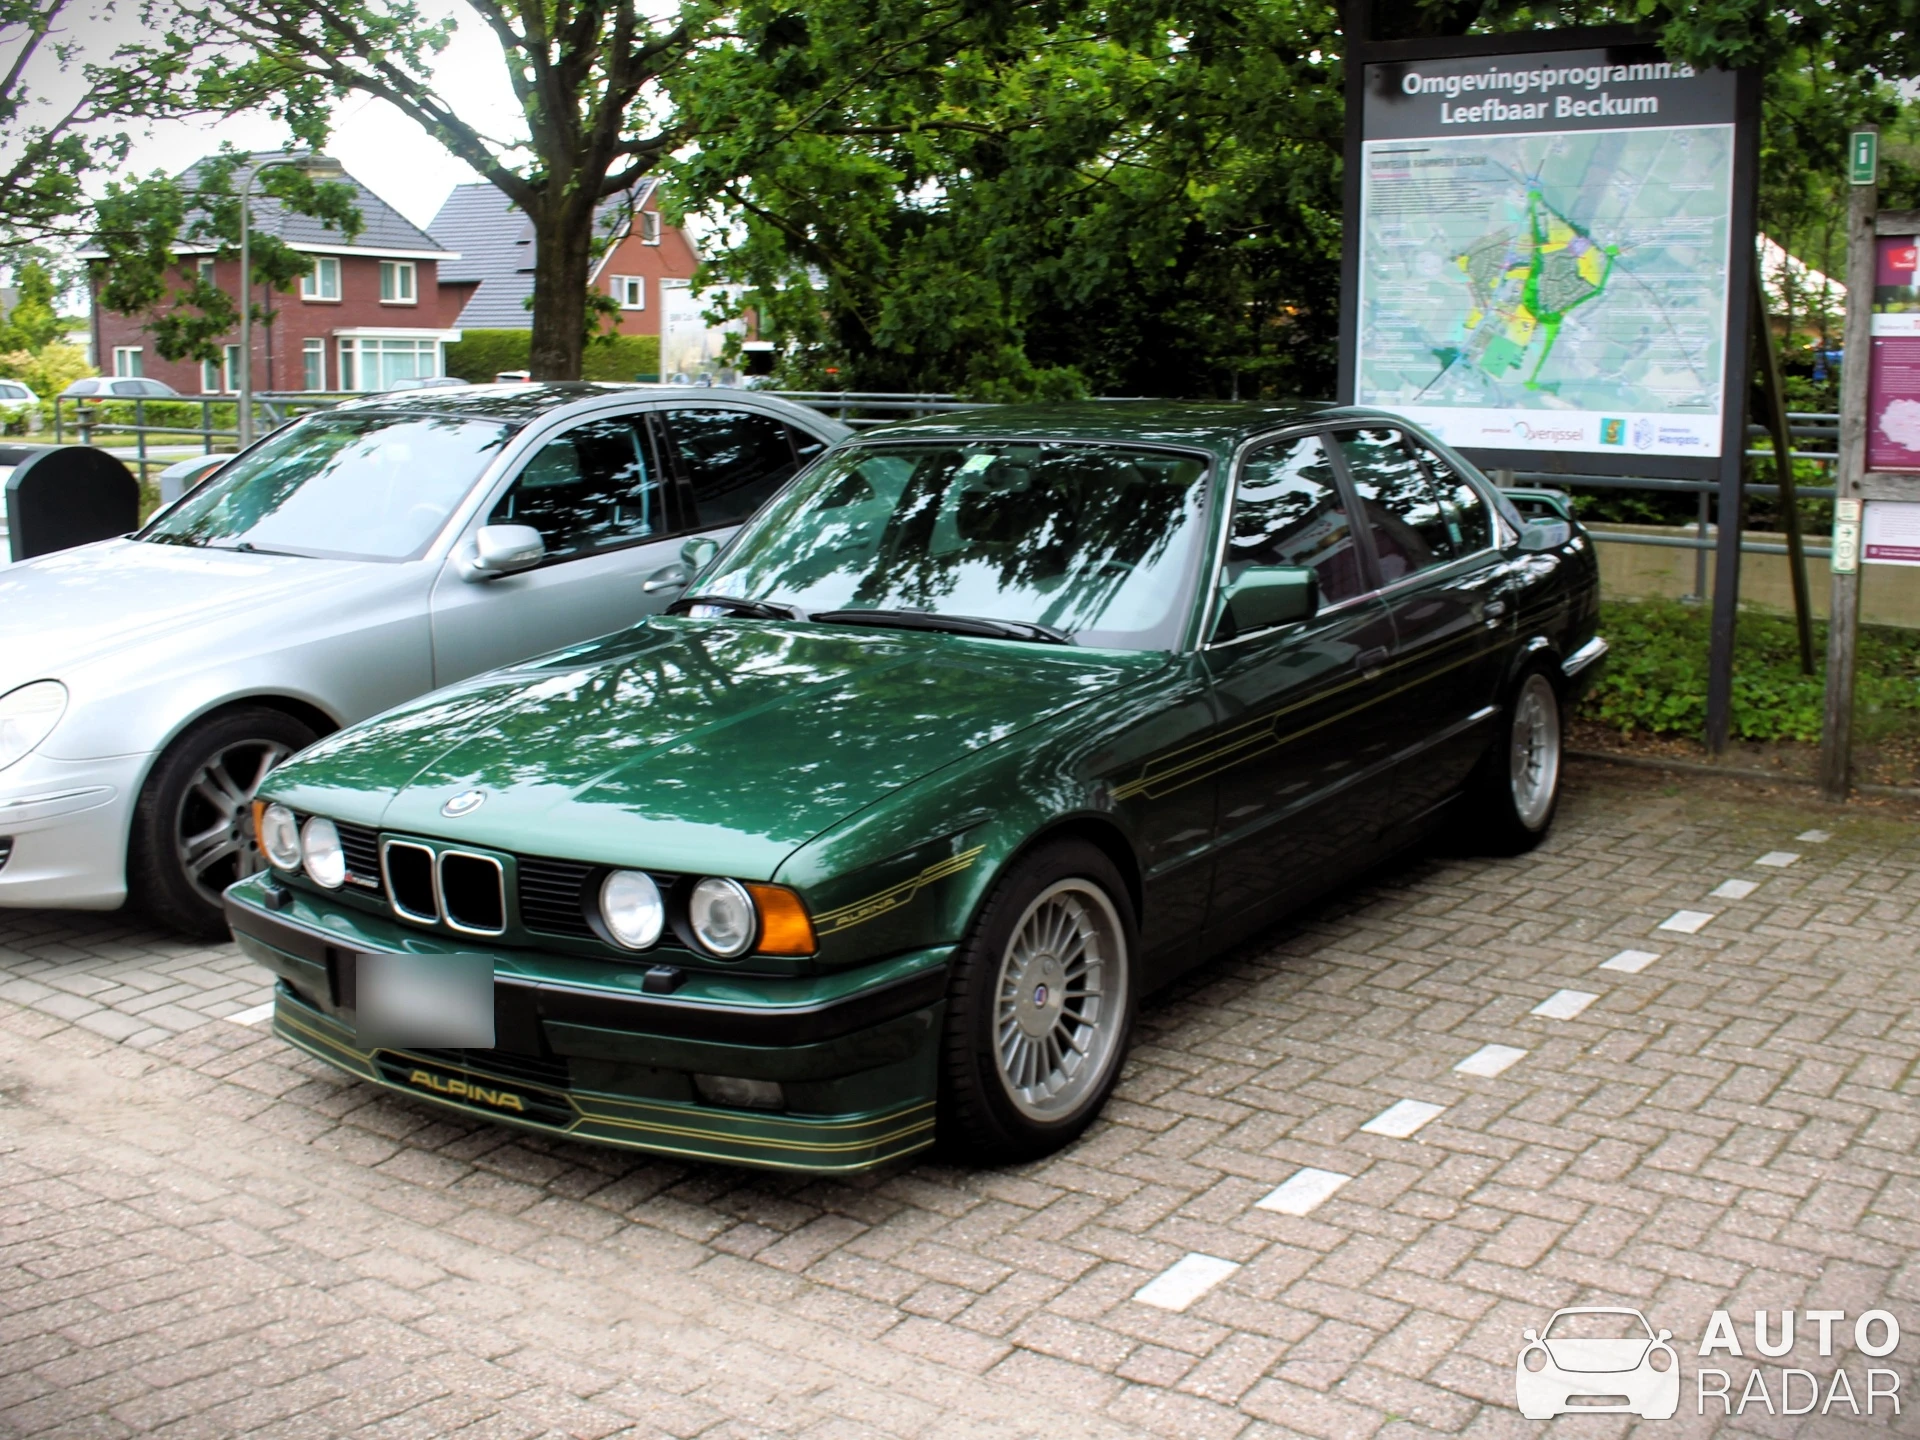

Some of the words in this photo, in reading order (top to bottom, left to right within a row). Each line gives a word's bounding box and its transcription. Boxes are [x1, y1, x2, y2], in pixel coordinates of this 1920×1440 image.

[1440, 99, 1549, 123] Leefbaar
[1555, 93, 1659, 119] Beckum
[835, 898, 895, 926] ALPINA
[410, 1069, 525, 1112] ALPINA
